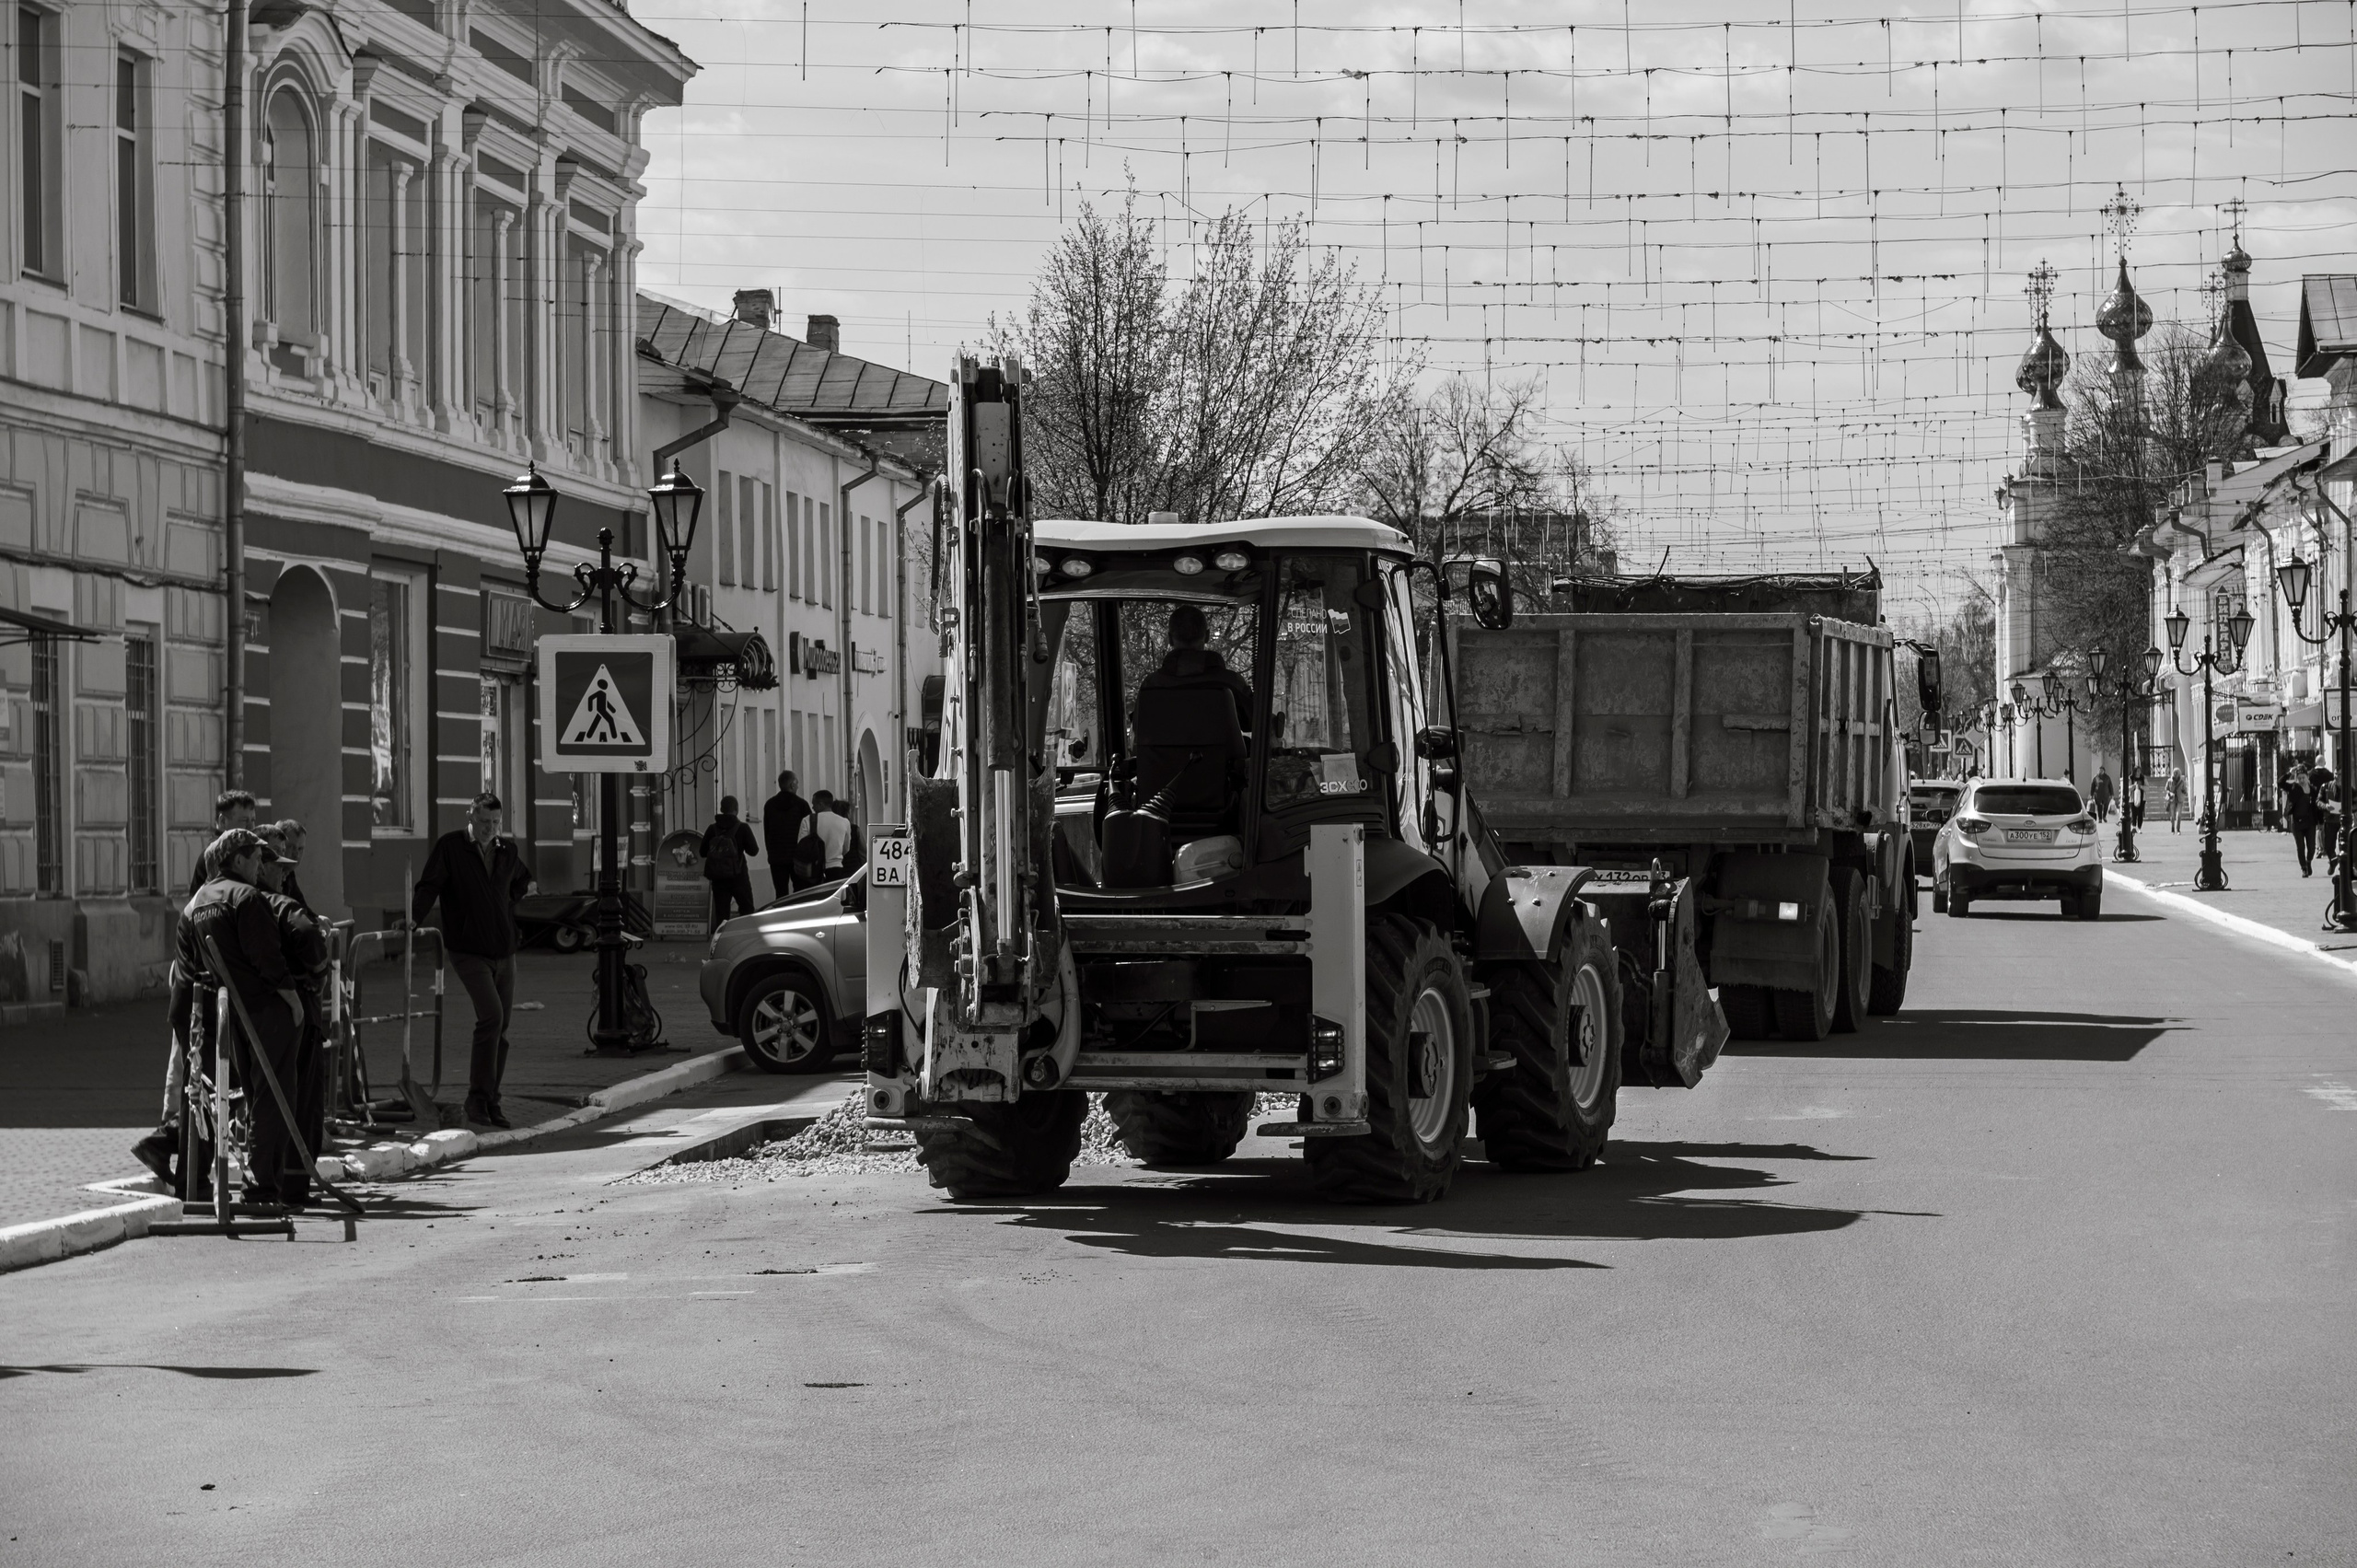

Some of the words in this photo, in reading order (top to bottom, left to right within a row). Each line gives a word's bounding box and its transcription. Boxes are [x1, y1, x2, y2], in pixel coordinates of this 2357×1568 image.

[1291, 609, 1327, 619] СДЕЛАНО
[1287, 622, 1293, 633] В
[1295, 622, 1328, 633] РОССИИ
[2218, 597, 2230, 660] БИЛЬЯРД
[877, 867, 900, 882] ВА
